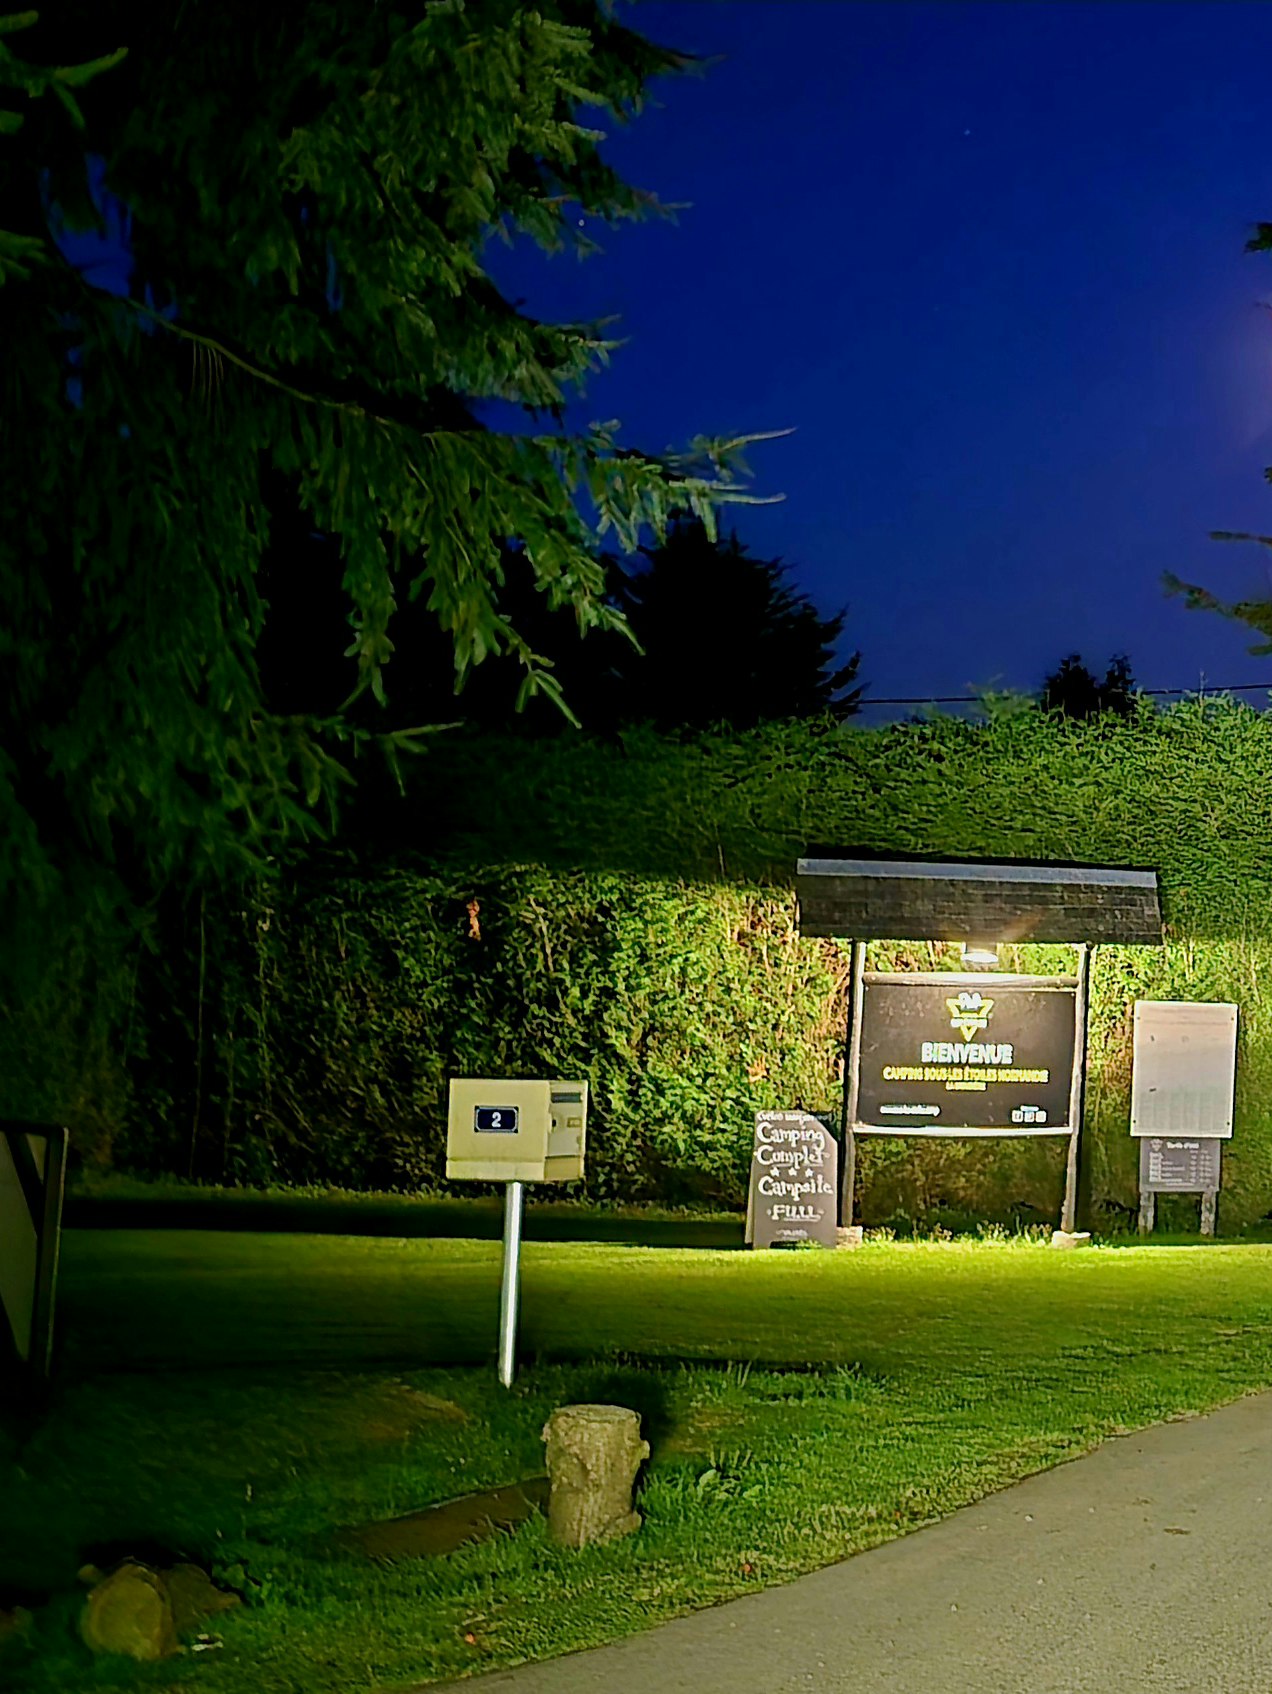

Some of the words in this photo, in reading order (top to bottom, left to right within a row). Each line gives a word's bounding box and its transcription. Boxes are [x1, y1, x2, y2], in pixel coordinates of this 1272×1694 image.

[921, 1042, 1013, 1065] BIENVENUE
[491, 1111, 502, 1128] 2
[757, 1121, 825, 1151] Camping
[758, 1174, 834, 1201] Campsite
[772, 1204, 822, 1221] FULL
